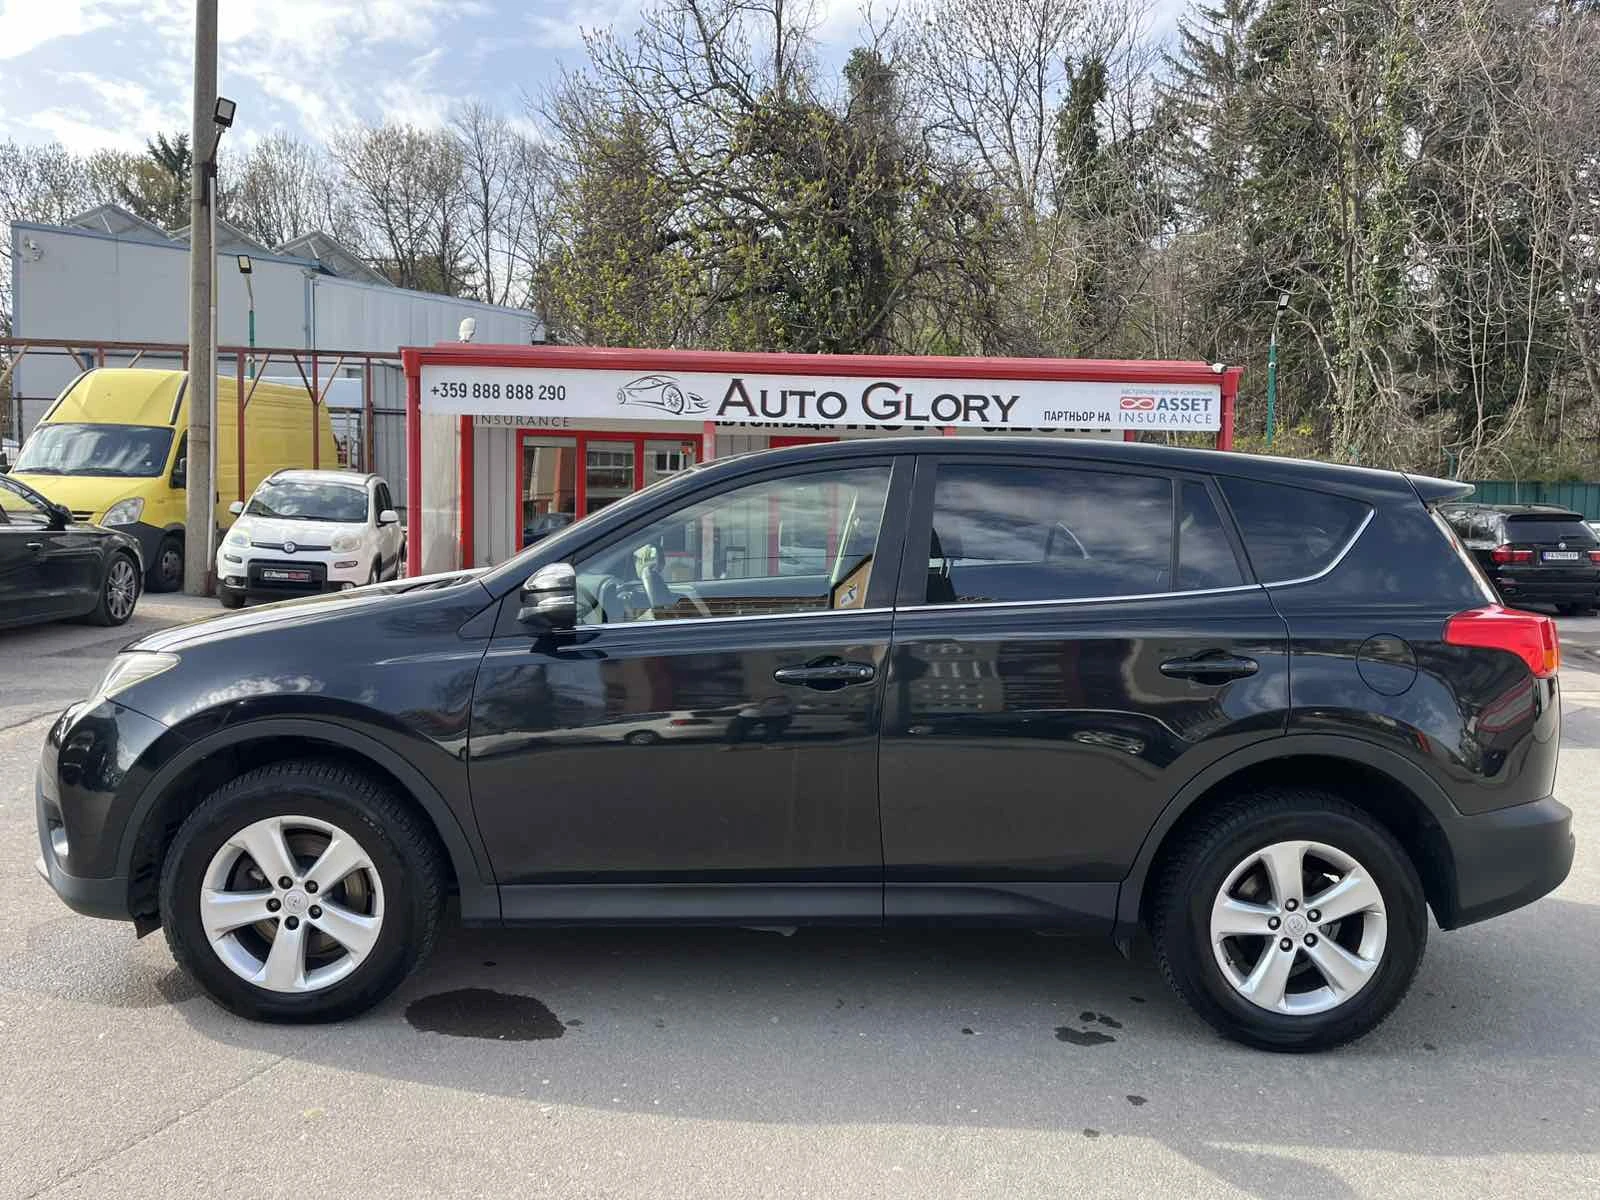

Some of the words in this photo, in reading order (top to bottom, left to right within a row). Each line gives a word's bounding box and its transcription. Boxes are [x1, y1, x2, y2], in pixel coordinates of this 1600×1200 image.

[430, 383, 467, 398] +359
[472, 383, 500, 399] 888
[506, 384, 533, 400] 888
[538, 385, 566, 400] 290
[716, 378, 847, 419] AUTO
[861, 382, 1020, 422] GLORY
[1156, 397, 1213, 411] ASSET
[475, 415, 569, 427] INSURANCE
[1044, 410, 1095, 421] ПАРТНЬОР
[1097, 411, 1111, 422] НА
[1119, 411, 1212, 424] INSURANCE
